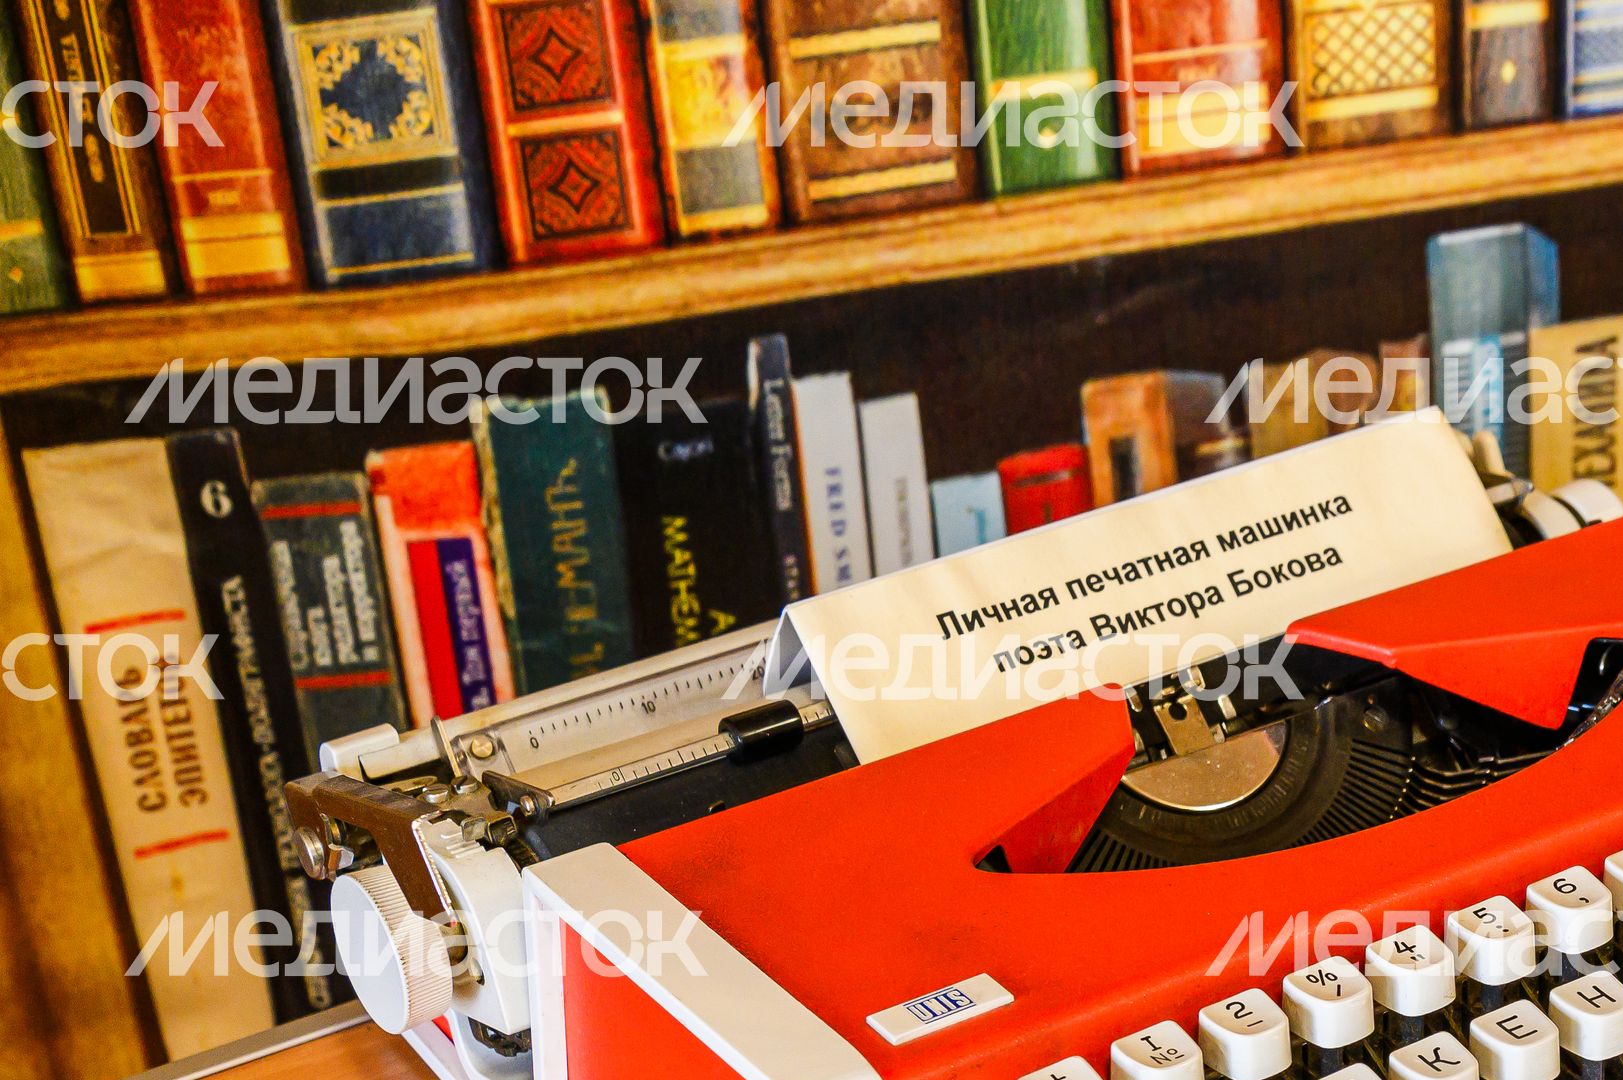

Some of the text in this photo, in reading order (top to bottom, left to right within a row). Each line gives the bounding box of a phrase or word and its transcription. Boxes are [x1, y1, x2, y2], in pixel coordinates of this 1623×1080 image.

[201, 480, 231, 518] 6
[936, 490, 1354, 642] Личная печатная машинка
[992, 543, 1343, 674] поэта Виктора Бокова
[905, 987, 976, 1023] UNIS
[1576, 985, 1618, 1009] Н
[1496, 1014, 1539, 1040] Е
[1417, 1046, 1462, 1073] К
